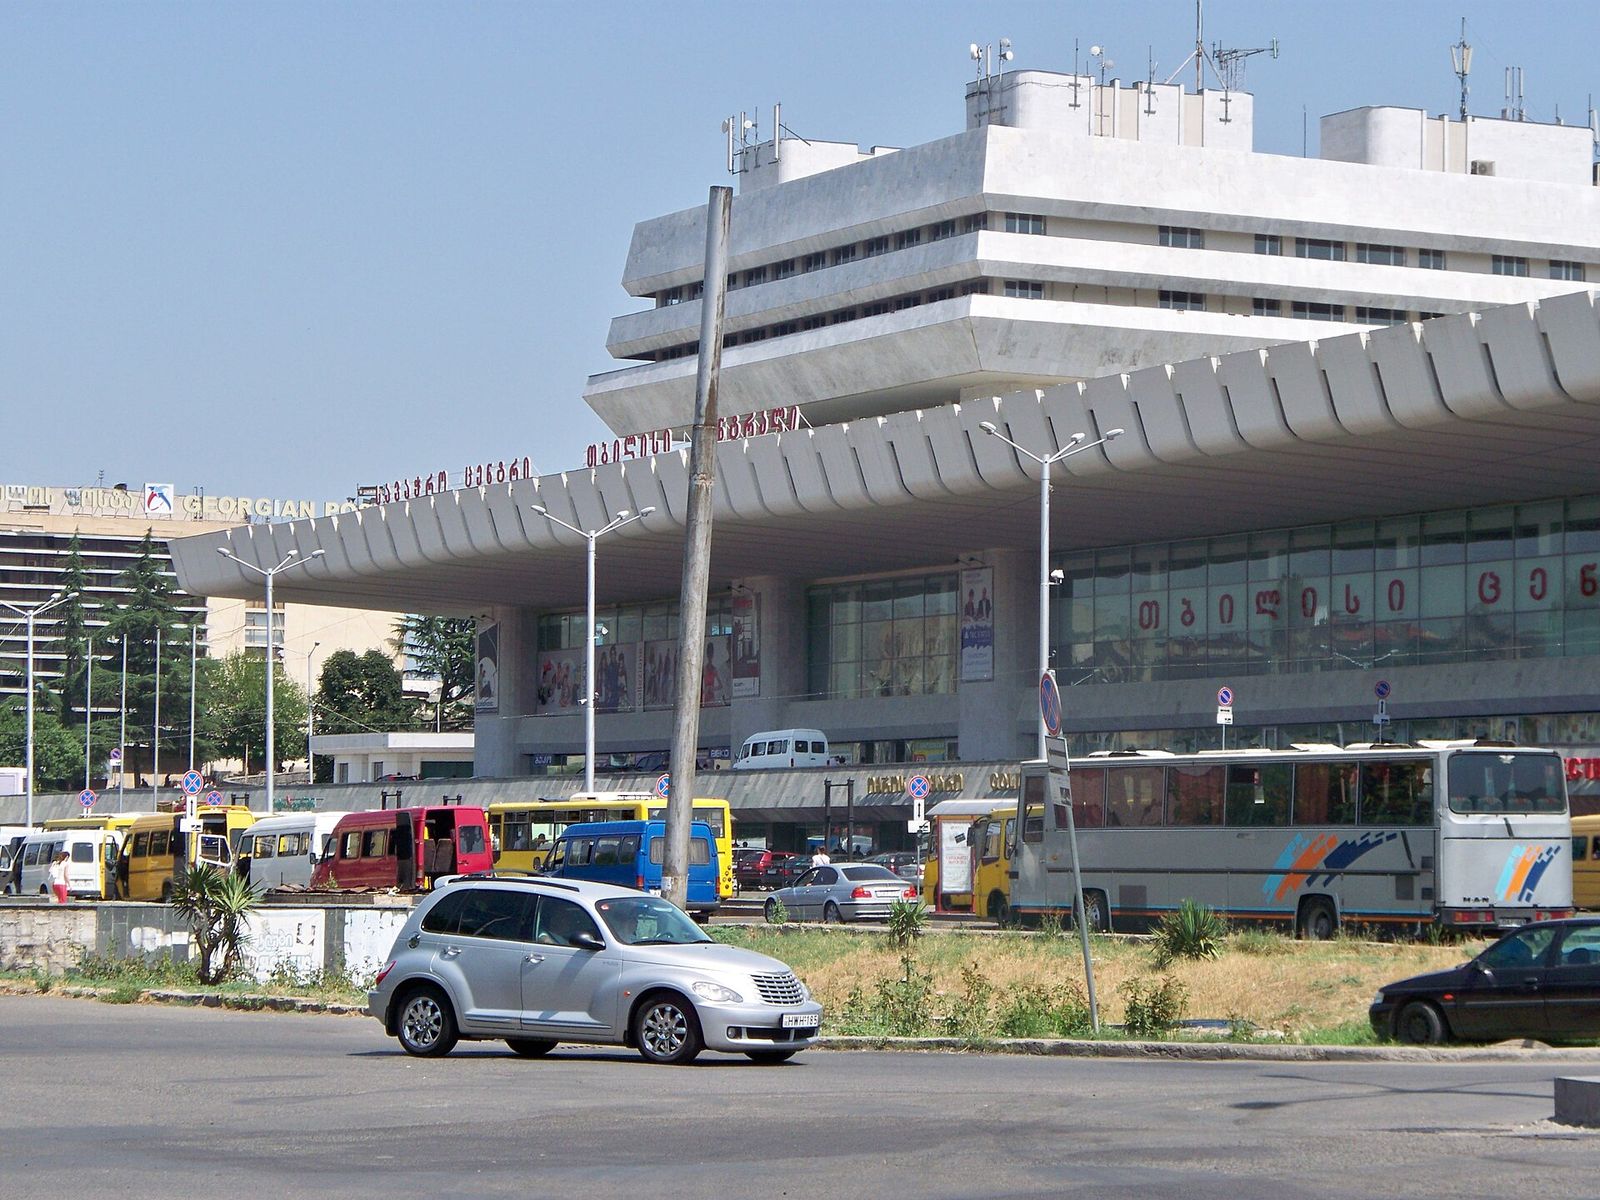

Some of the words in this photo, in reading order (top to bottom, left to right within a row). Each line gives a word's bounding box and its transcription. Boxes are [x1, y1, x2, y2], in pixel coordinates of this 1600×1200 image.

[586, 428, 673, 468] თბილისი
[716, 405, 800, 441] ნტრალი
[0, 485, 54, 506] ლოს
[375, 470, 448, 506] სავაჭრო
[464, 456, 532, 488] ცენტრი
[182, 495, 316, 518] GEORGIAN
[1138, 578, 1406, 631] თბილისი
[1478, 562, 1598, 605] ცენ
